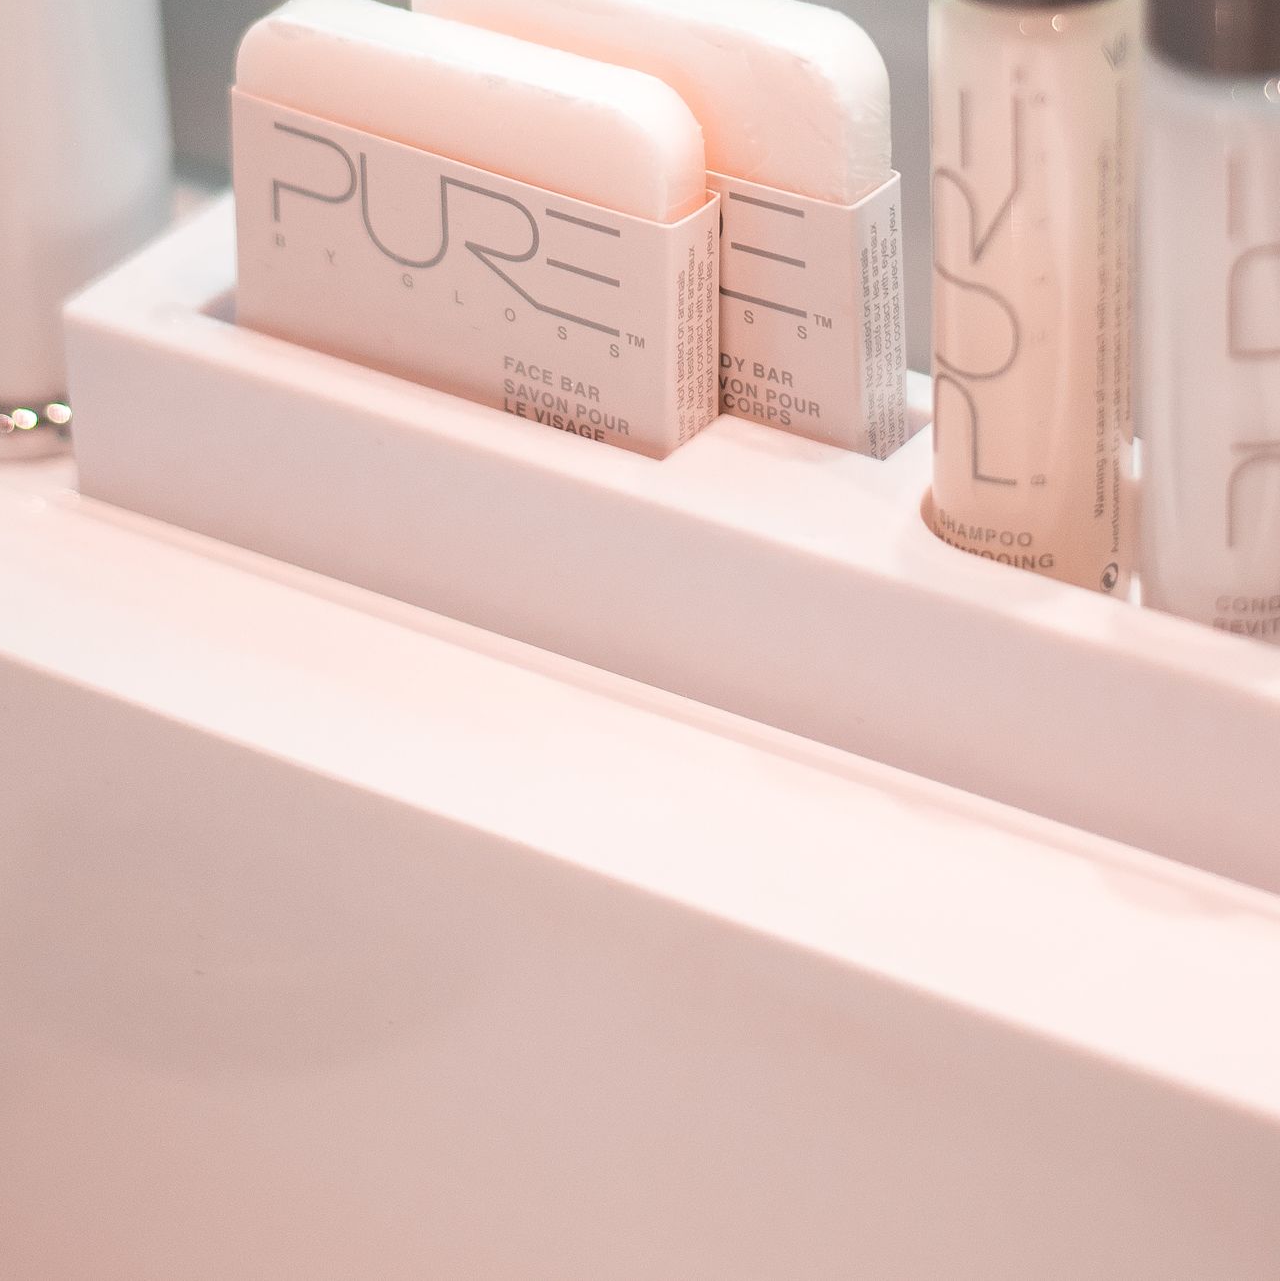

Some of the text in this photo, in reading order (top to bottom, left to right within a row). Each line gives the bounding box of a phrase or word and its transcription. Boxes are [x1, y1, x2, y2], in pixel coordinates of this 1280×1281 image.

[273, 121, 621, 337] PURE
[504, 355, 600, 402] FACE BAR
[720, 352, 794, 388] DY BAR
[503, 378, 631, 437] SAVON POUR
[503, 397, 606, 441] LE VISAGE
[723, 393, 792, 426] CORPS
[765, 386, 821, 418] POUR
[939, 509, 1034, 547] SHAMPOO
